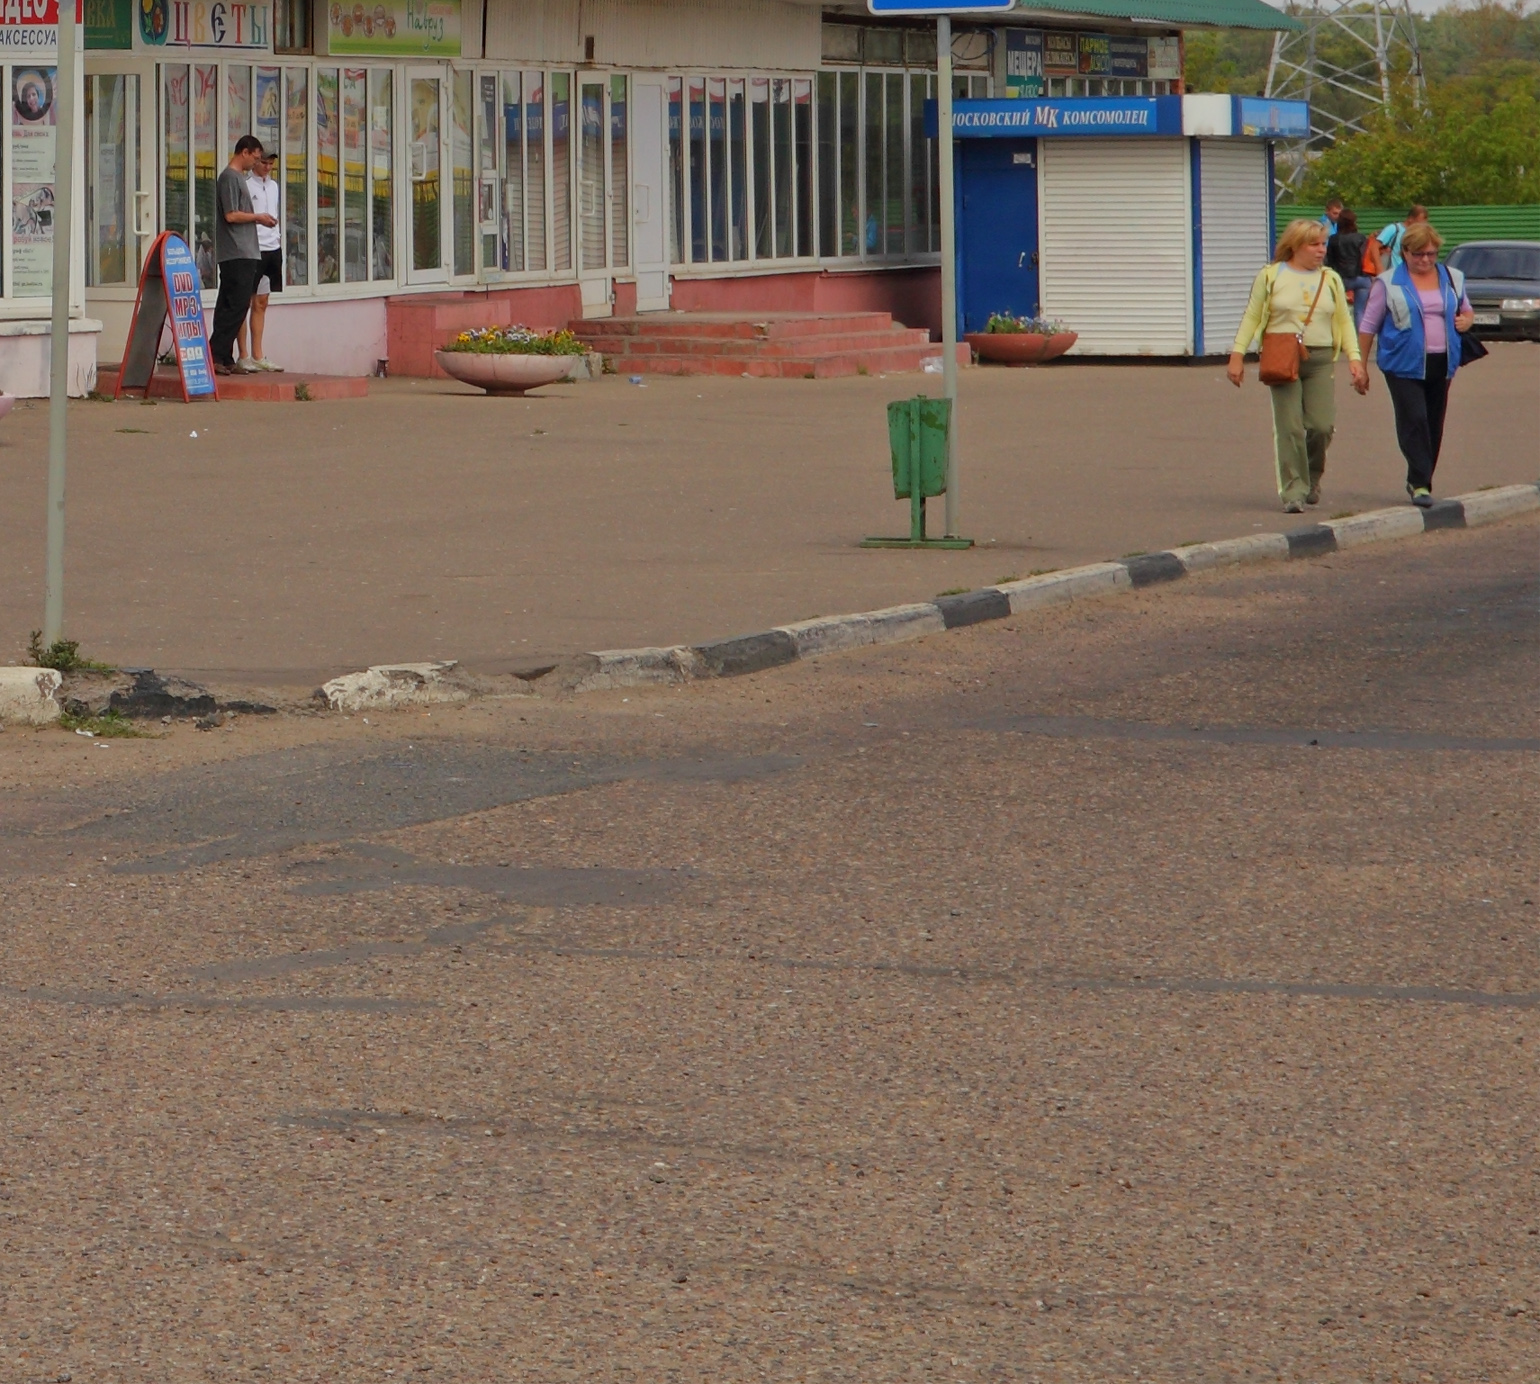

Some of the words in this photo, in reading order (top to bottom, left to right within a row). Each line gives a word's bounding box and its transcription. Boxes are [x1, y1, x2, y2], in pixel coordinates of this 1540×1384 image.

[174, 0, 269, 51] ЦВЕТЫ
[1062, 109, 1149, 126] КОМСОМОЛЕЦ
[172, 272, 194, 294] DVD
